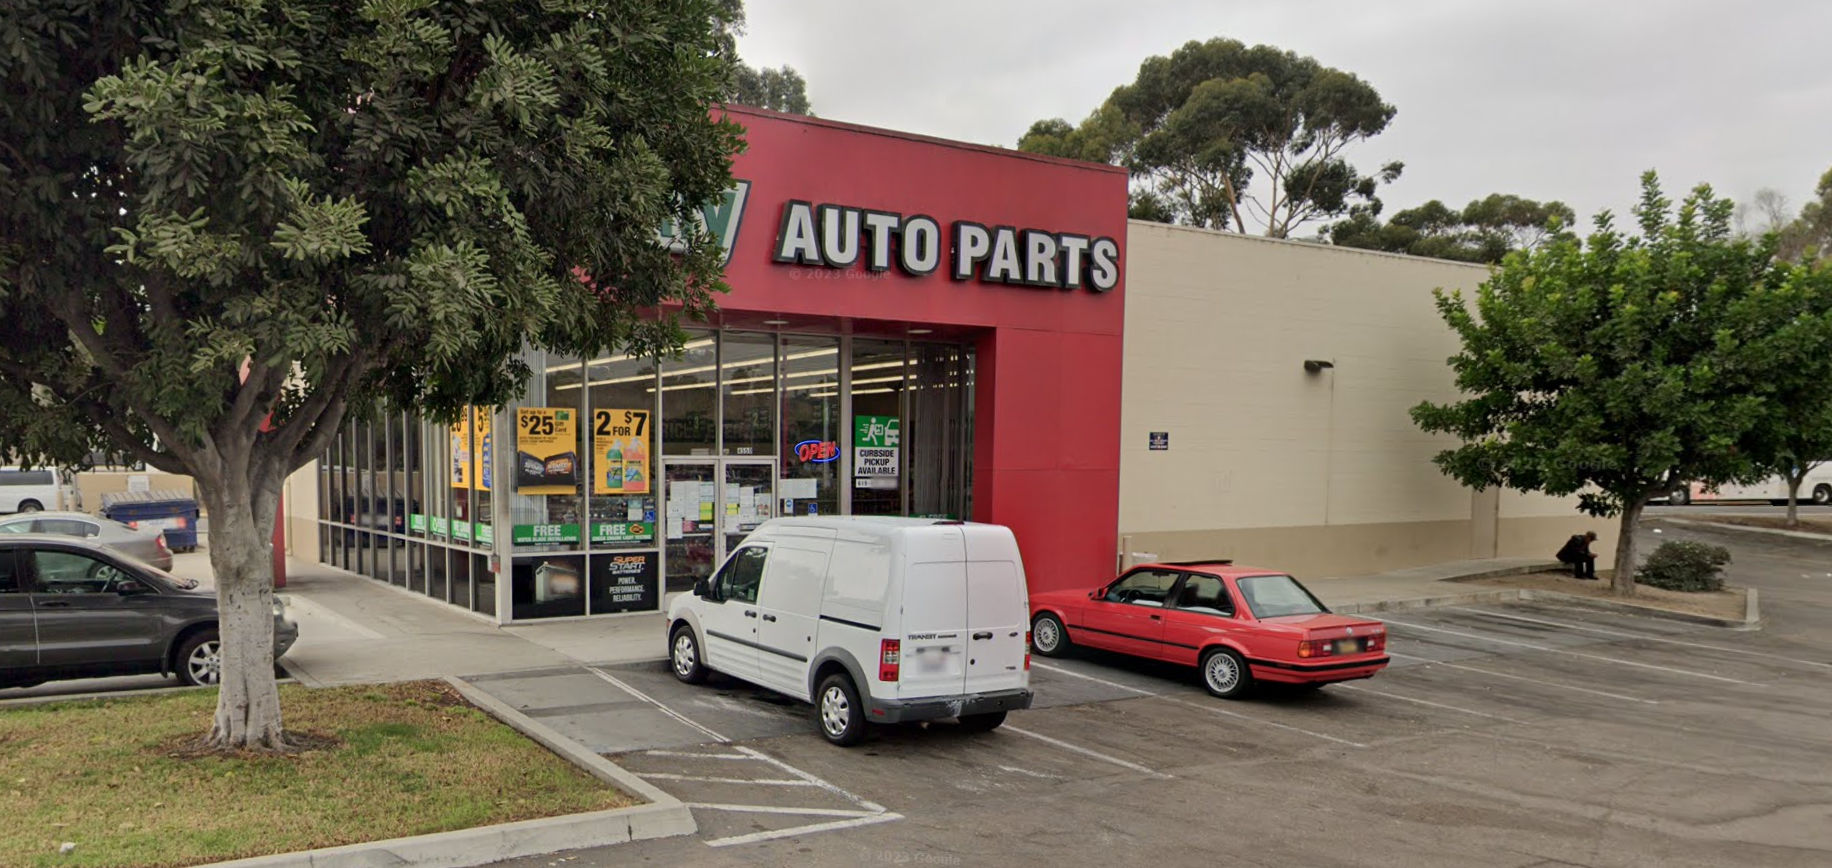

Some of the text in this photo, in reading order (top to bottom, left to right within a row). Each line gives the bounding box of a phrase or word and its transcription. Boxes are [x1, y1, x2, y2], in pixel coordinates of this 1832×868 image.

[774, 198, 942, 276] AUTO
[951, 219, 1120, 292] PARTS
[521, 415, 554, 435] $25
[596, 410, 647, 437] 2 FOR $7
[799, 441, 836, 462] OPEN
[859, 449, 895, 457] CURBSIDE
[864, 458, 890, 466] PICKUP
[857, 466, 896, 475] AVAILABLE
[533, 525, 561, 537] FREE
[600, 524, 626, 536] FREE
